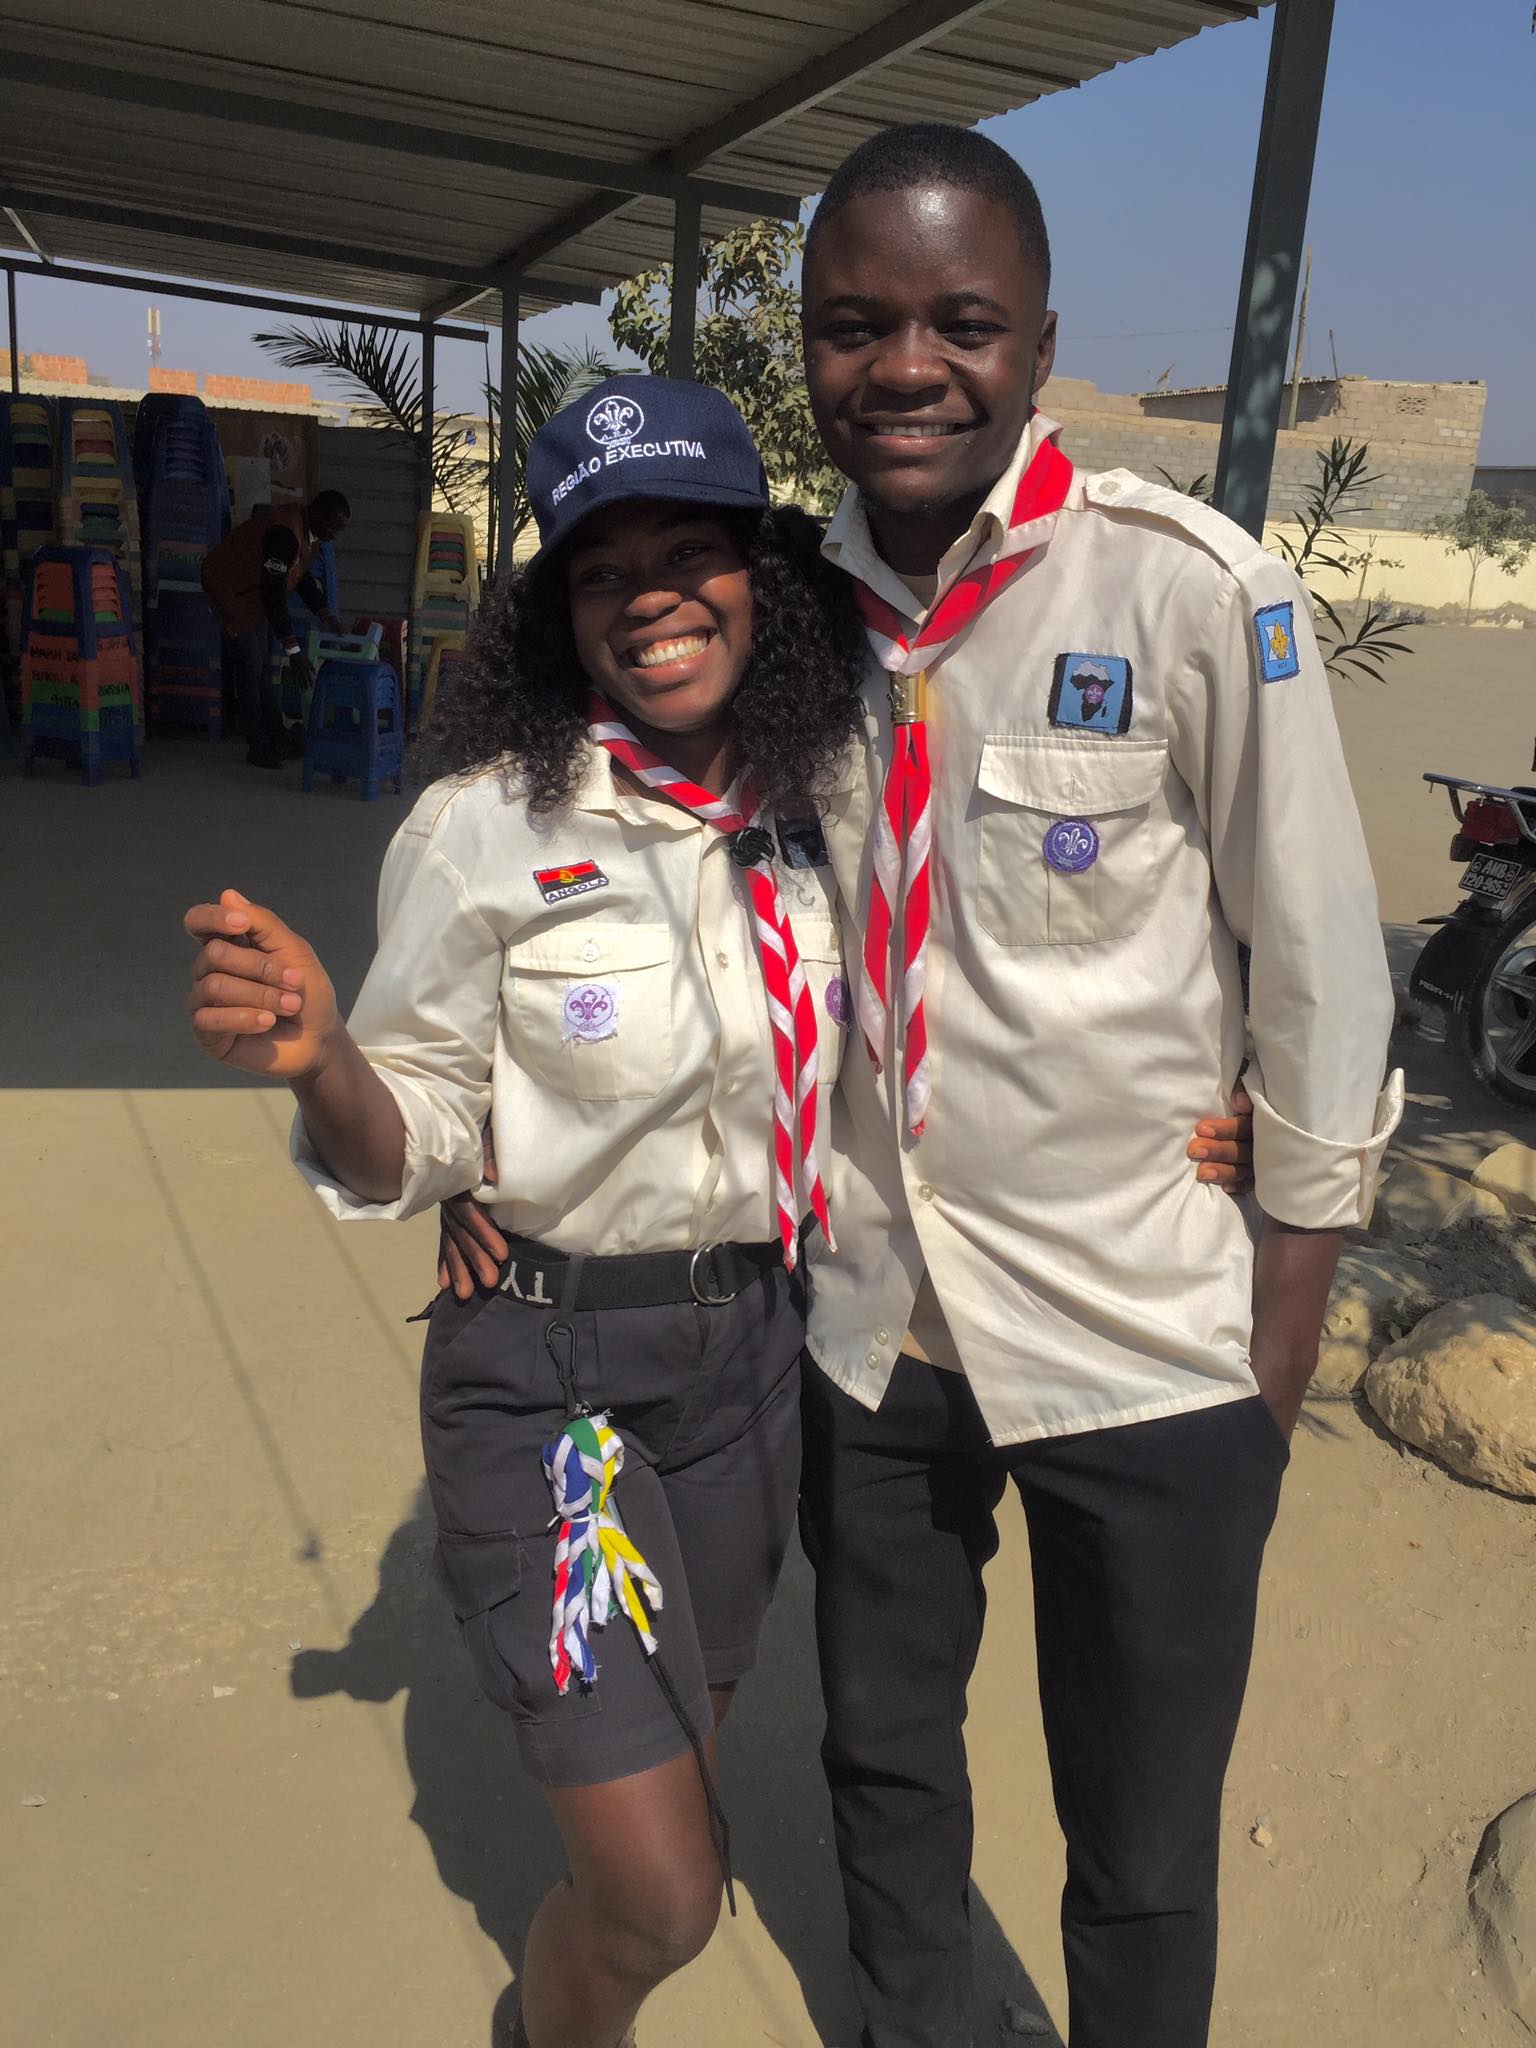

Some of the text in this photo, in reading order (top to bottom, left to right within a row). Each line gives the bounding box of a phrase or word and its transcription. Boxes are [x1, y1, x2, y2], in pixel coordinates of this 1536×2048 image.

[552, 440, 706, 505] REGIÃO EXECUTIVA
[548, 879, 605, 900] ANGOLA
